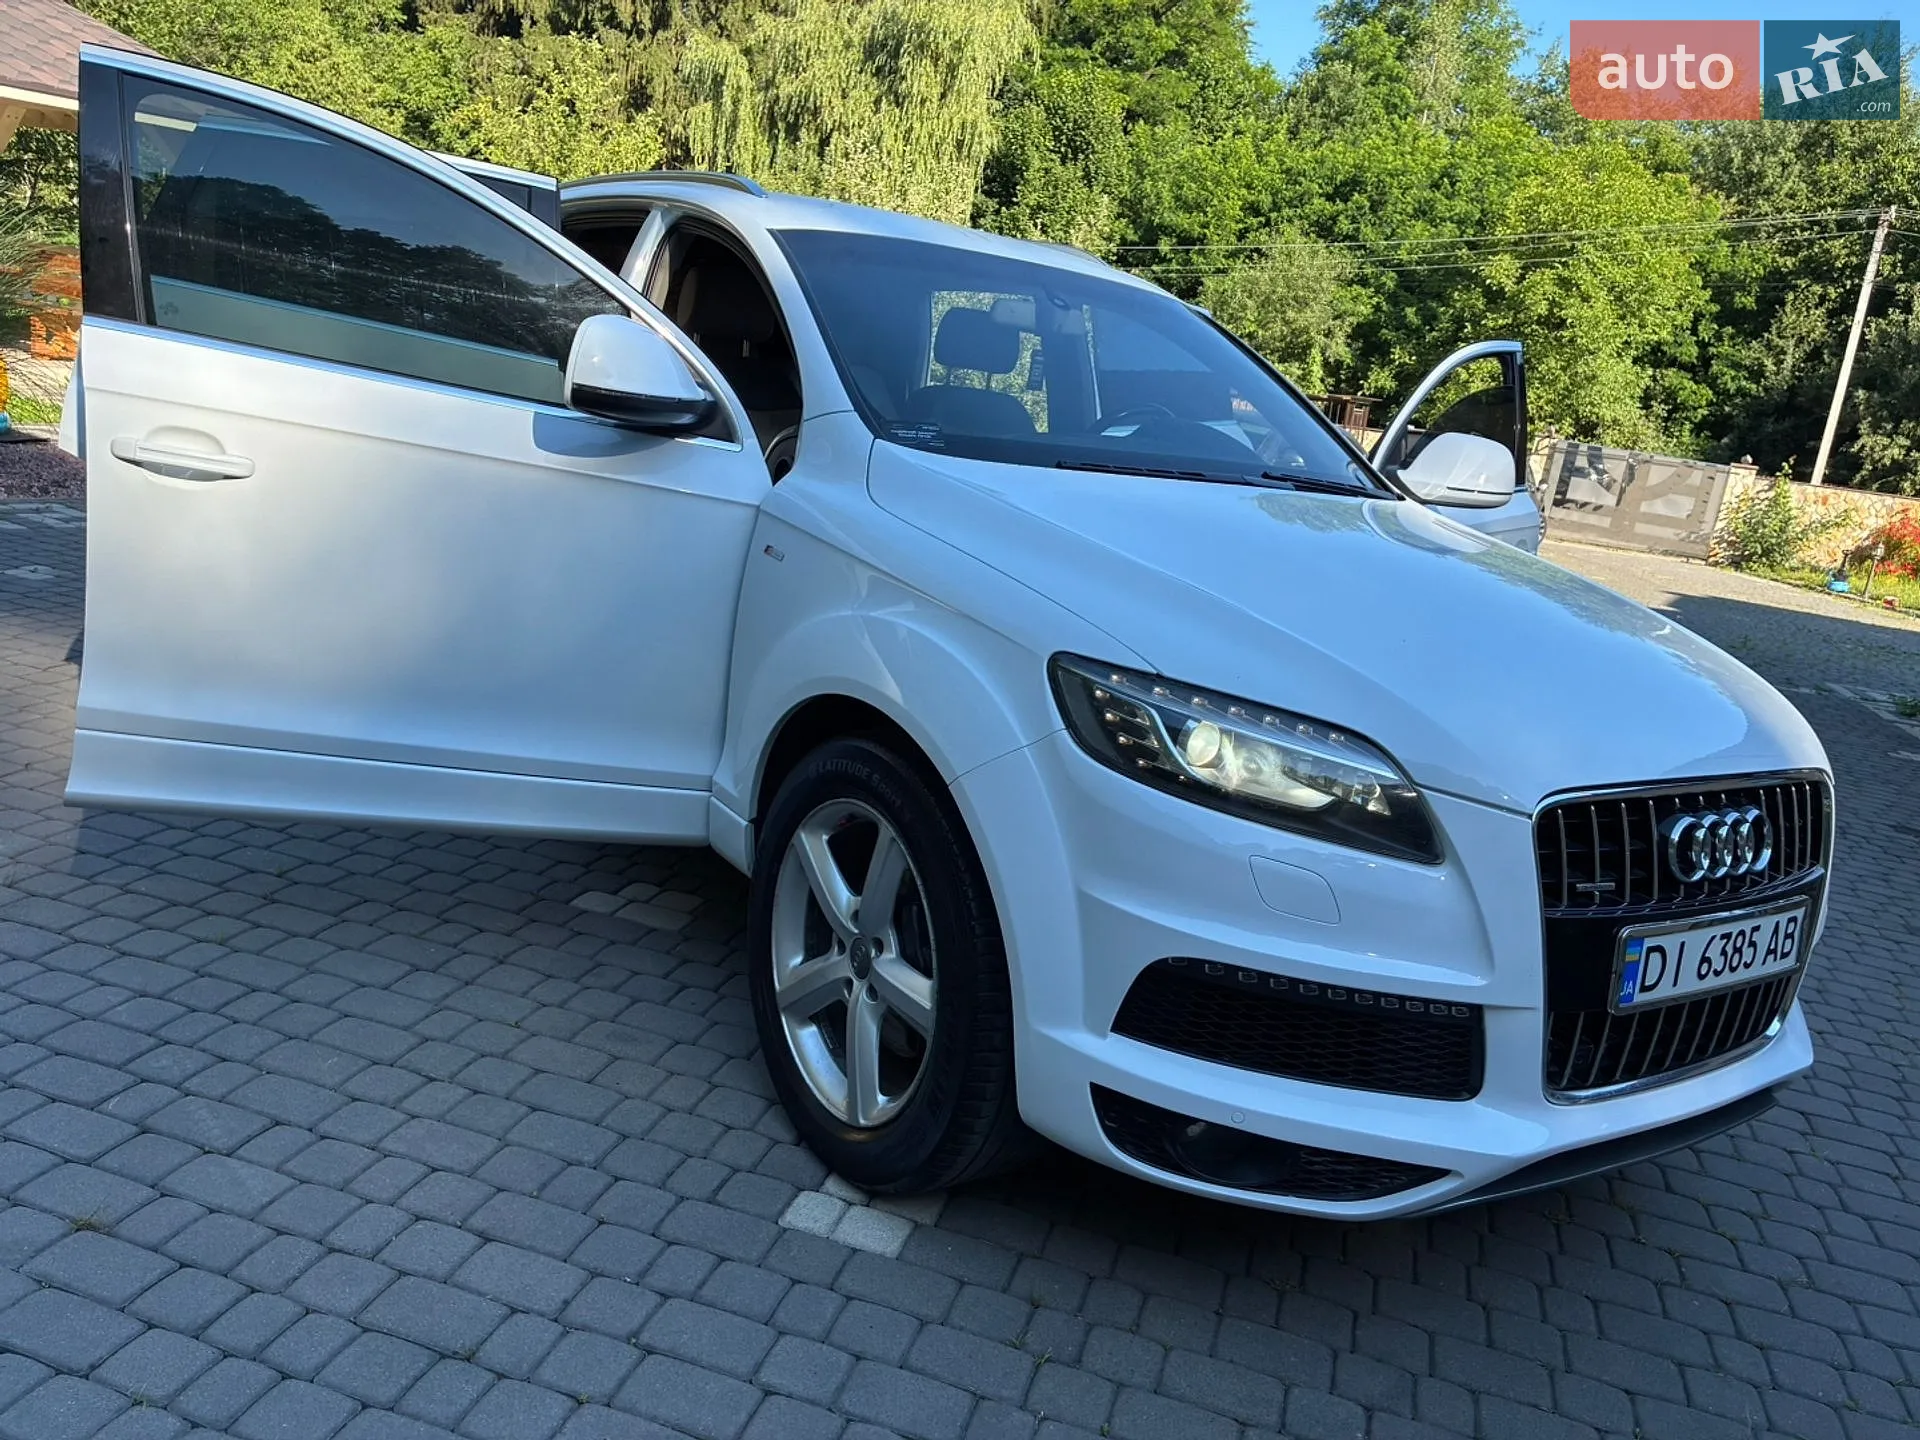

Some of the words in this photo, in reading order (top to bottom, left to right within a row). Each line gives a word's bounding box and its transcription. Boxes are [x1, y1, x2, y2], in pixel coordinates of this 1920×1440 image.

[818, 758, 870, 778] LATITUDE
[1639, 941, 1686, 994] DI
[1696, 924, 1761, 982] 6385
[1761, 915, 1799, 965] AB
